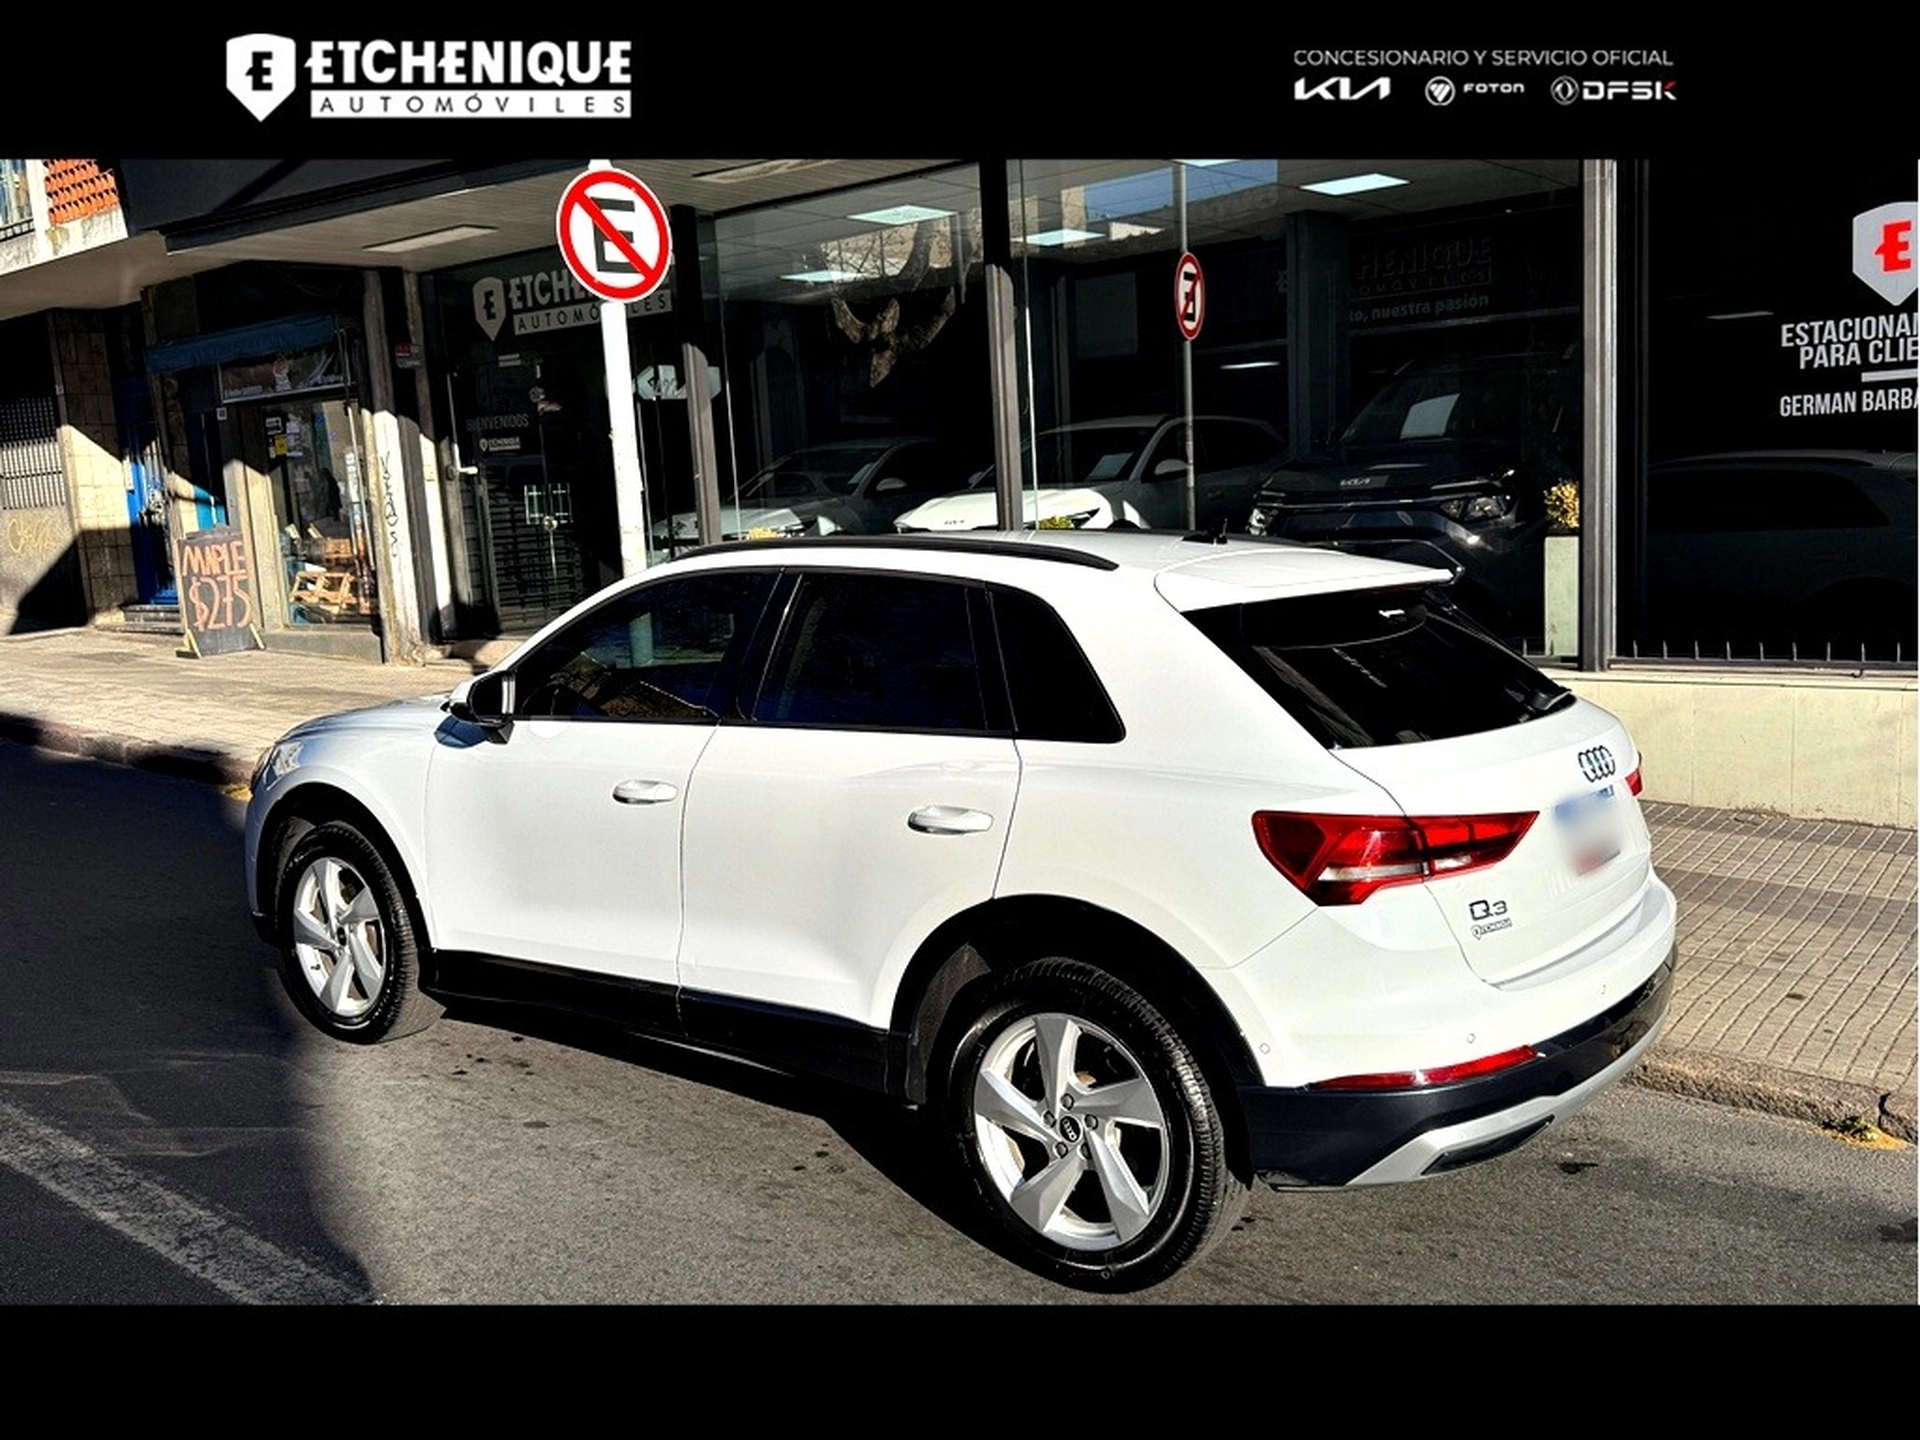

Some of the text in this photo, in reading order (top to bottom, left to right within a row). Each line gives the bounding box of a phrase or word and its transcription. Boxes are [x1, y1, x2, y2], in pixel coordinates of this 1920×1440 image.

[518, 293, 667, 332] AUTOMÓLES
[1800, 343, 1862, 370] PARA
[1780, 391, 1857, 417] GERMAN
[189, 574, 253, 632] $275
[1469, 899, 1508, 921] Q3
